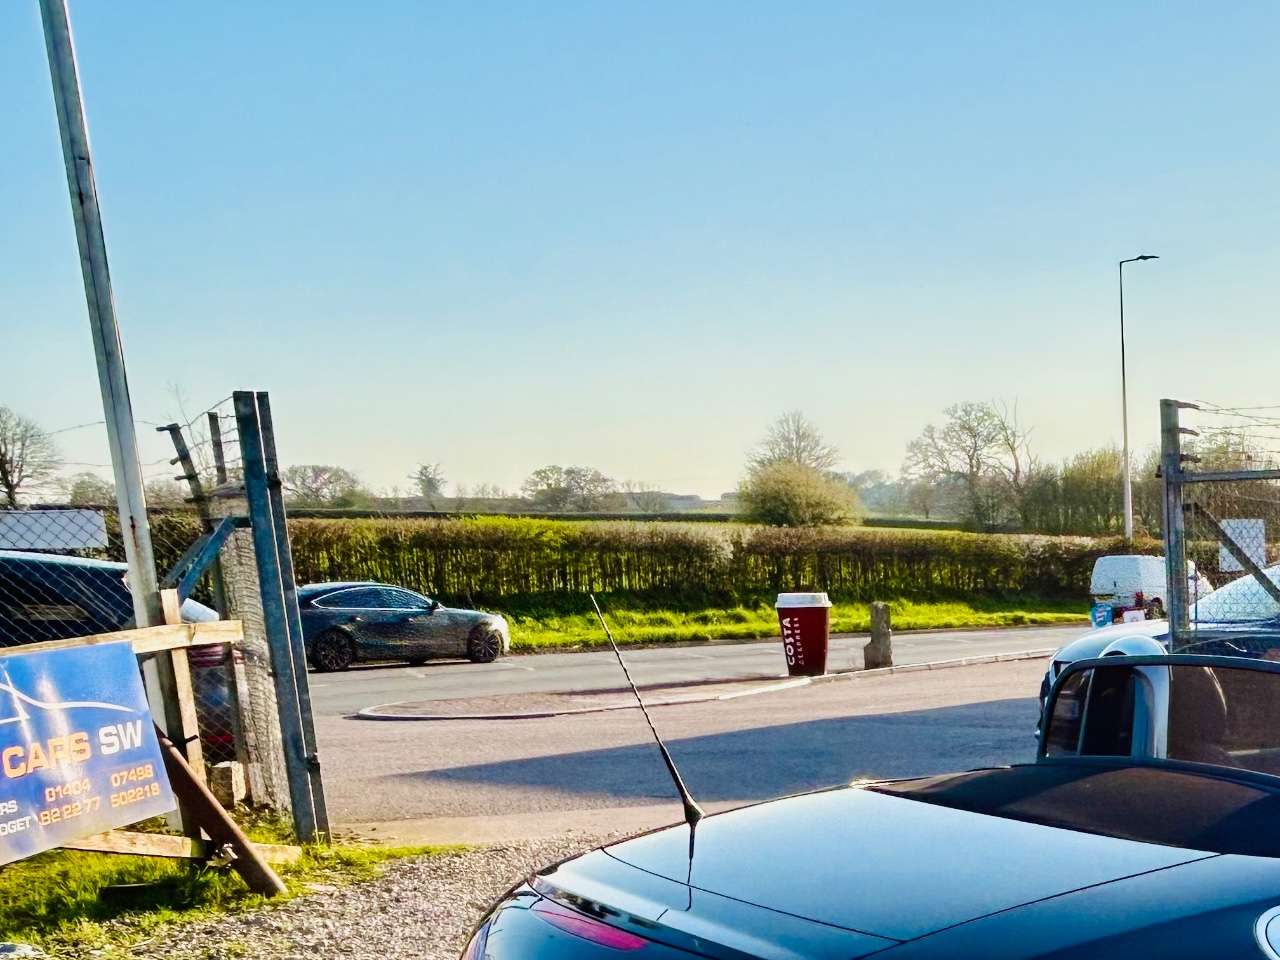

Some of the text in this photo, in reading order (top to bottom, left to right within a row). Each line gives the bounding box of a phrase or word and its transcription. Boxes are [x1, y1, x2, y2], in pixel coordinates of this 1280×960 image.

[782, 618, 795, 665] COSTA
[2, 719, 143, 779] CARS SW
